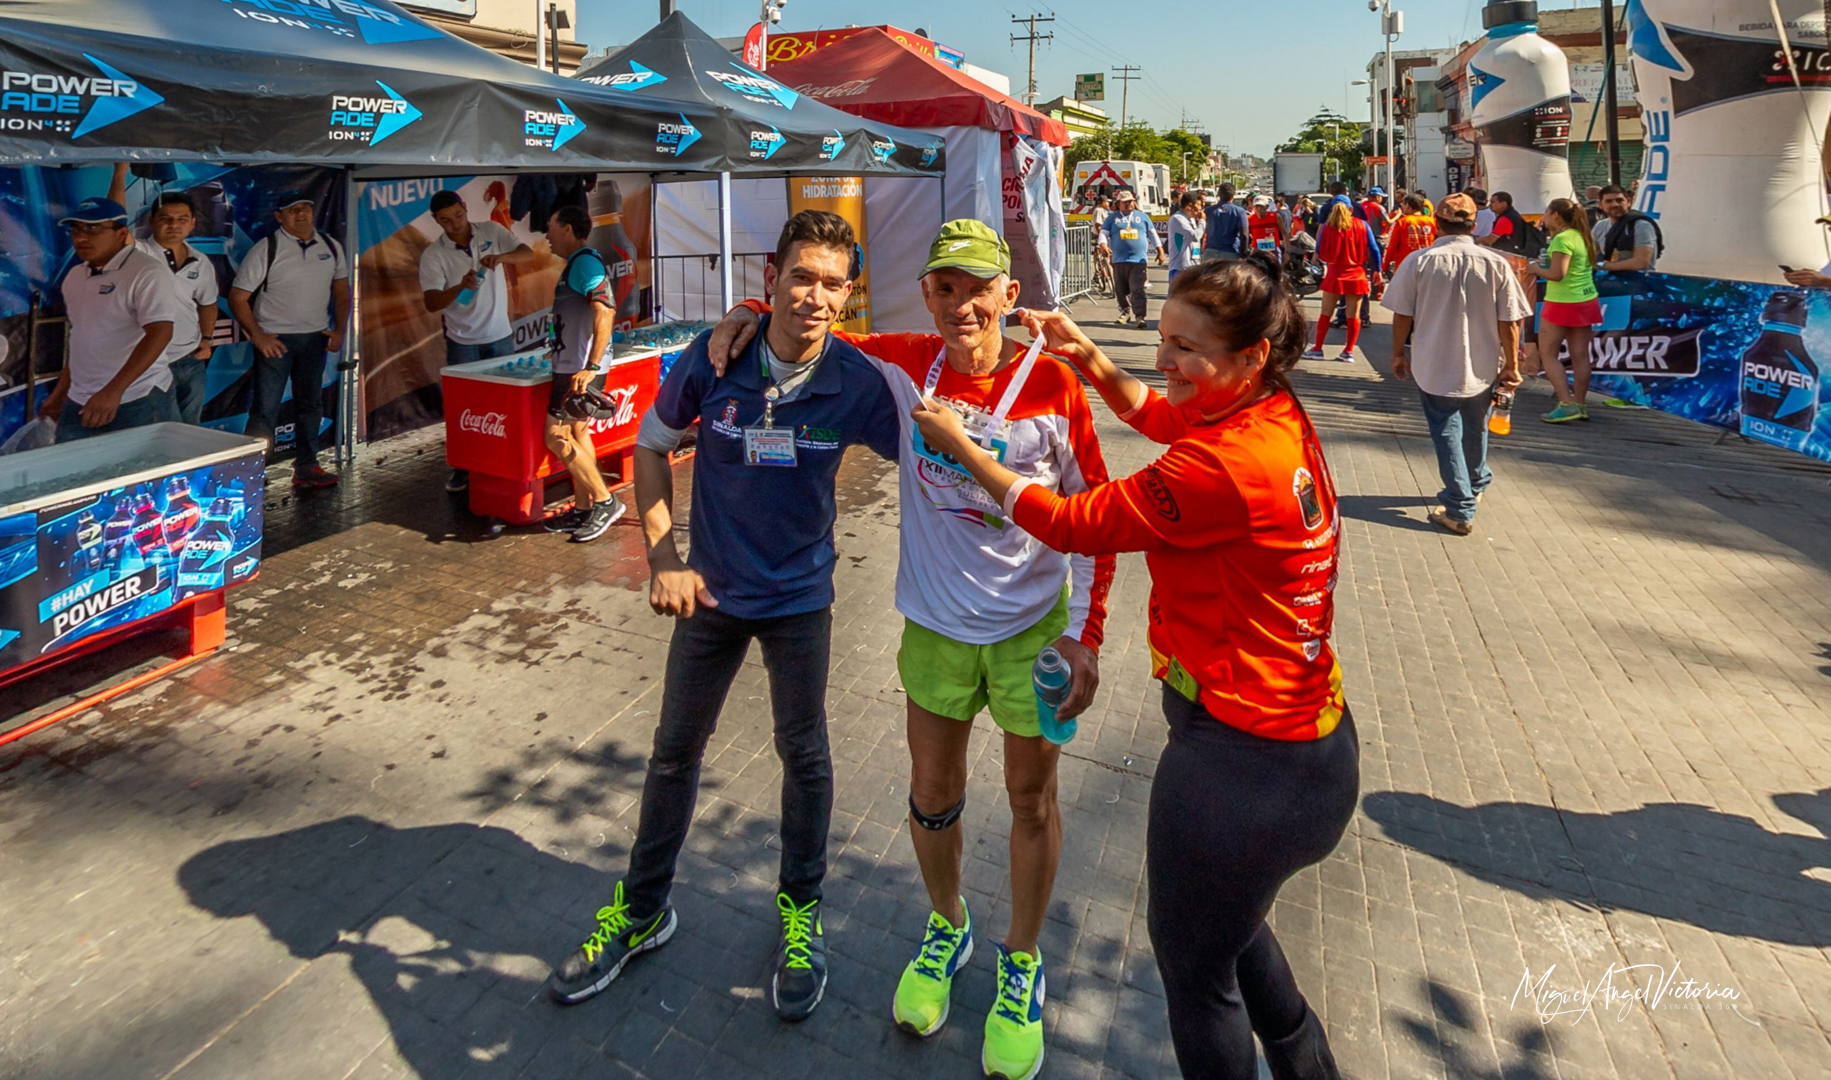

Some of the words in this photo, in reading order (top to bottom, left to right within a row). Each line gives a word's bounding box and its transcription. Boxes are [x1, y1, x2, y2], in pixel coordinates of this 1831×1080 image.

[3, 71, 138, 98] POWER
[705, 70, 784, 92] POWER
[1, 91, 81, 114] ADE
[332, 95, 408, 114] POWER
[330, 110, 374, 127] ADE
[525, 110, 576, 126] POWER
[525, 122, 555, 136] ADE
[658, 122, 695, 136] POWER
[656, 133, 679, 144] ADE
[751, 131, 781, 143] POWER
[1743, 376, 1782, 398] ADE
[1744, 361, 1814, 391] POWER
[460, 408, 507, 438] Coca-Cola
[50, 578, 95, 613] #HAY
[53, 575, 142, 637] POWER
